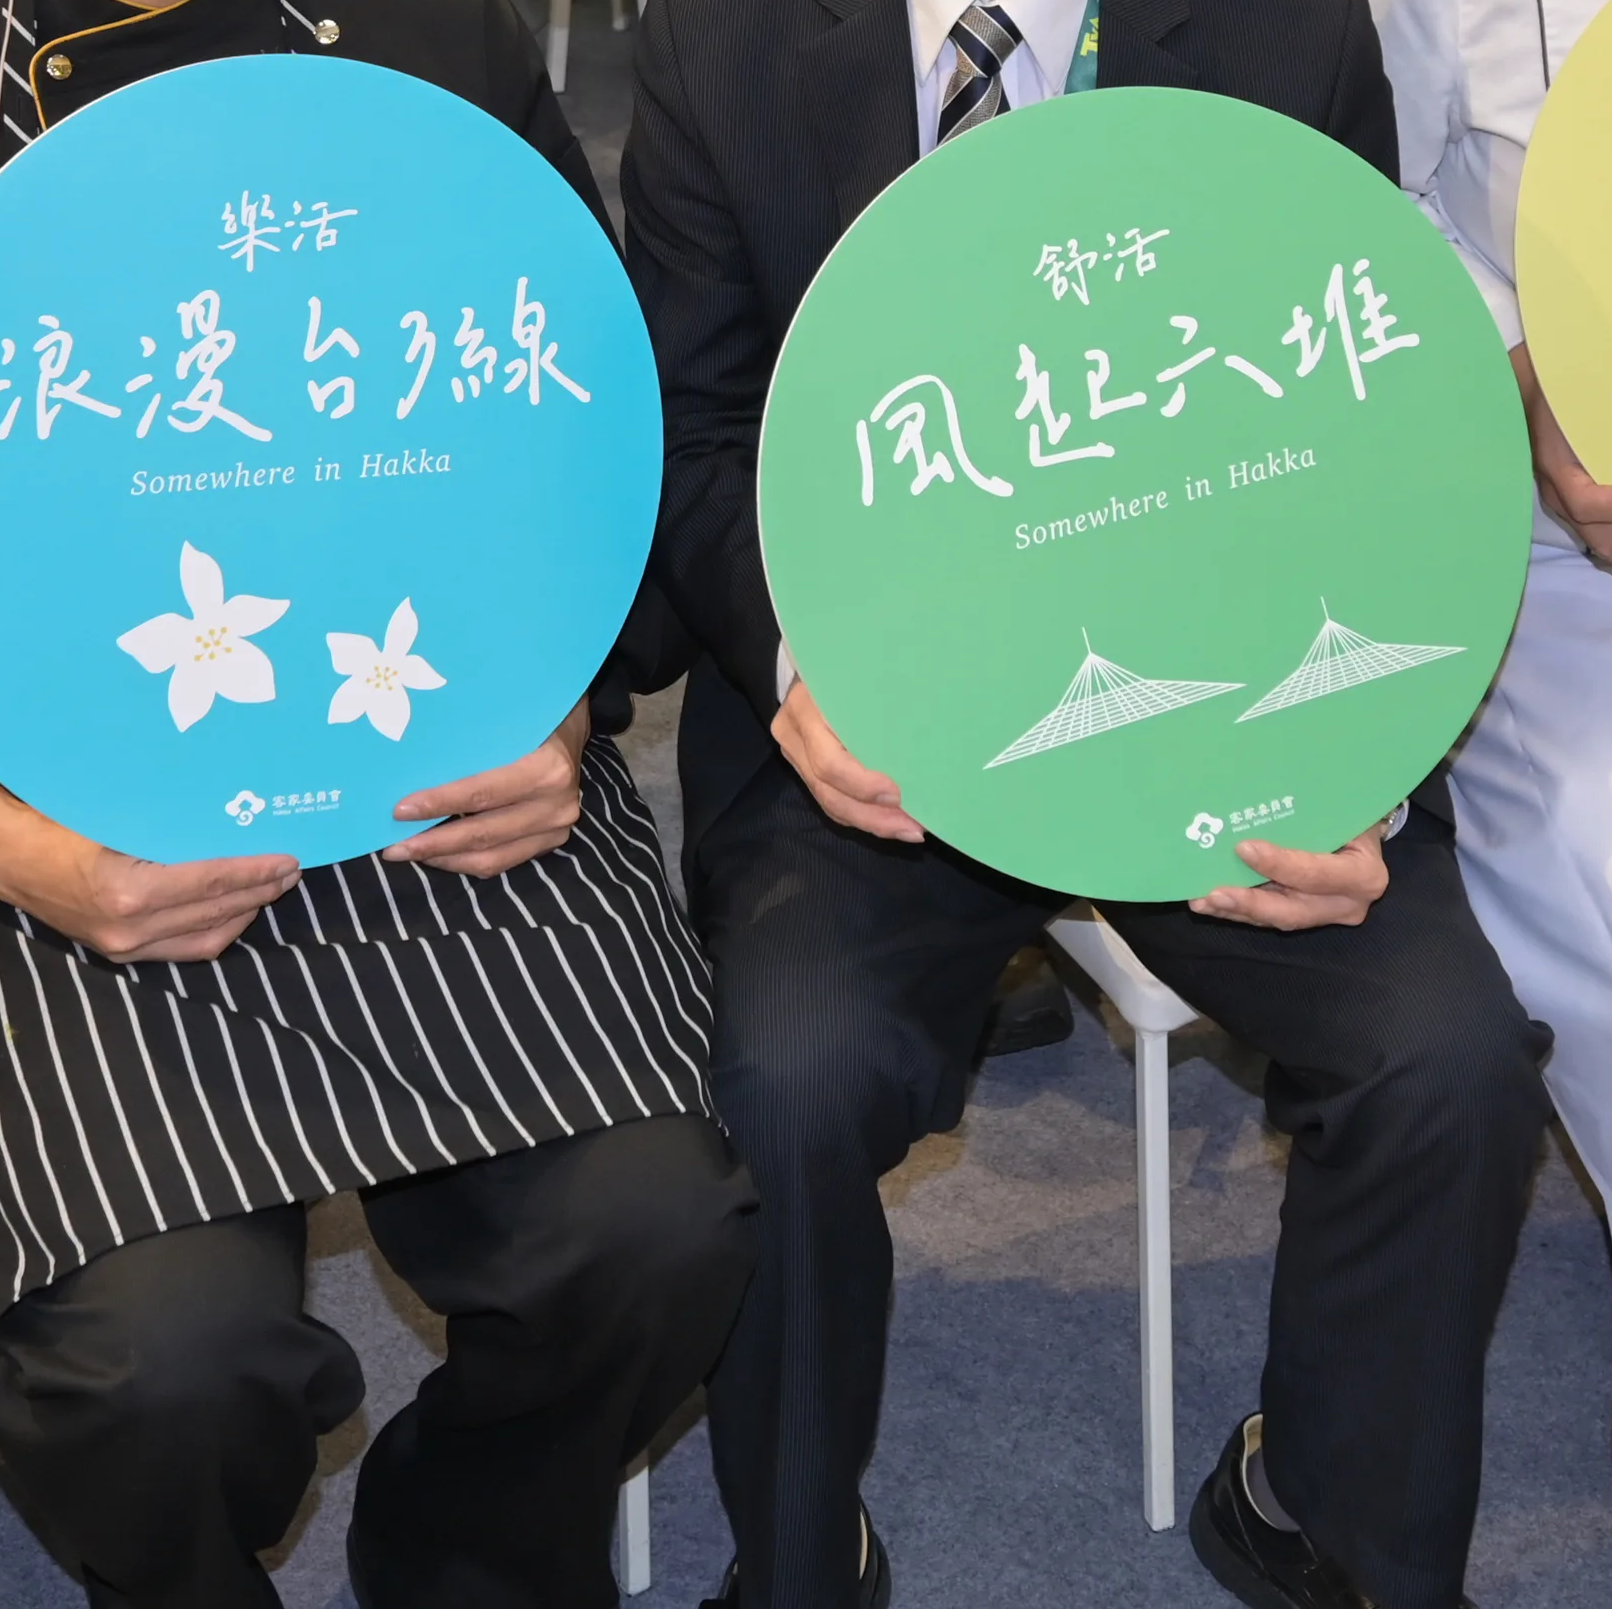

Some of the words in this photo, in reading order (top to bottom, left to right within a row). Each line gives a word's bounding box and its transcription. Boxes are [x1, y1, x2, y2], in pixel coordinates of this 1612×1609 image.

[216, 190, 360, 273] 樂活
[1033, 226, 1171, 307] 舒活
[855, 257, 1421, 508] 風起六堆
[130, 460, 296, 497] Somewhere
[314, 456, 342, 482] in
[358, 449, 452, 481] Hakka
[1014, 488, 1171, 551] Somewhere
[1185, 475, 1213, 504] in
[1228, 445, 1318, 491] Hakka
